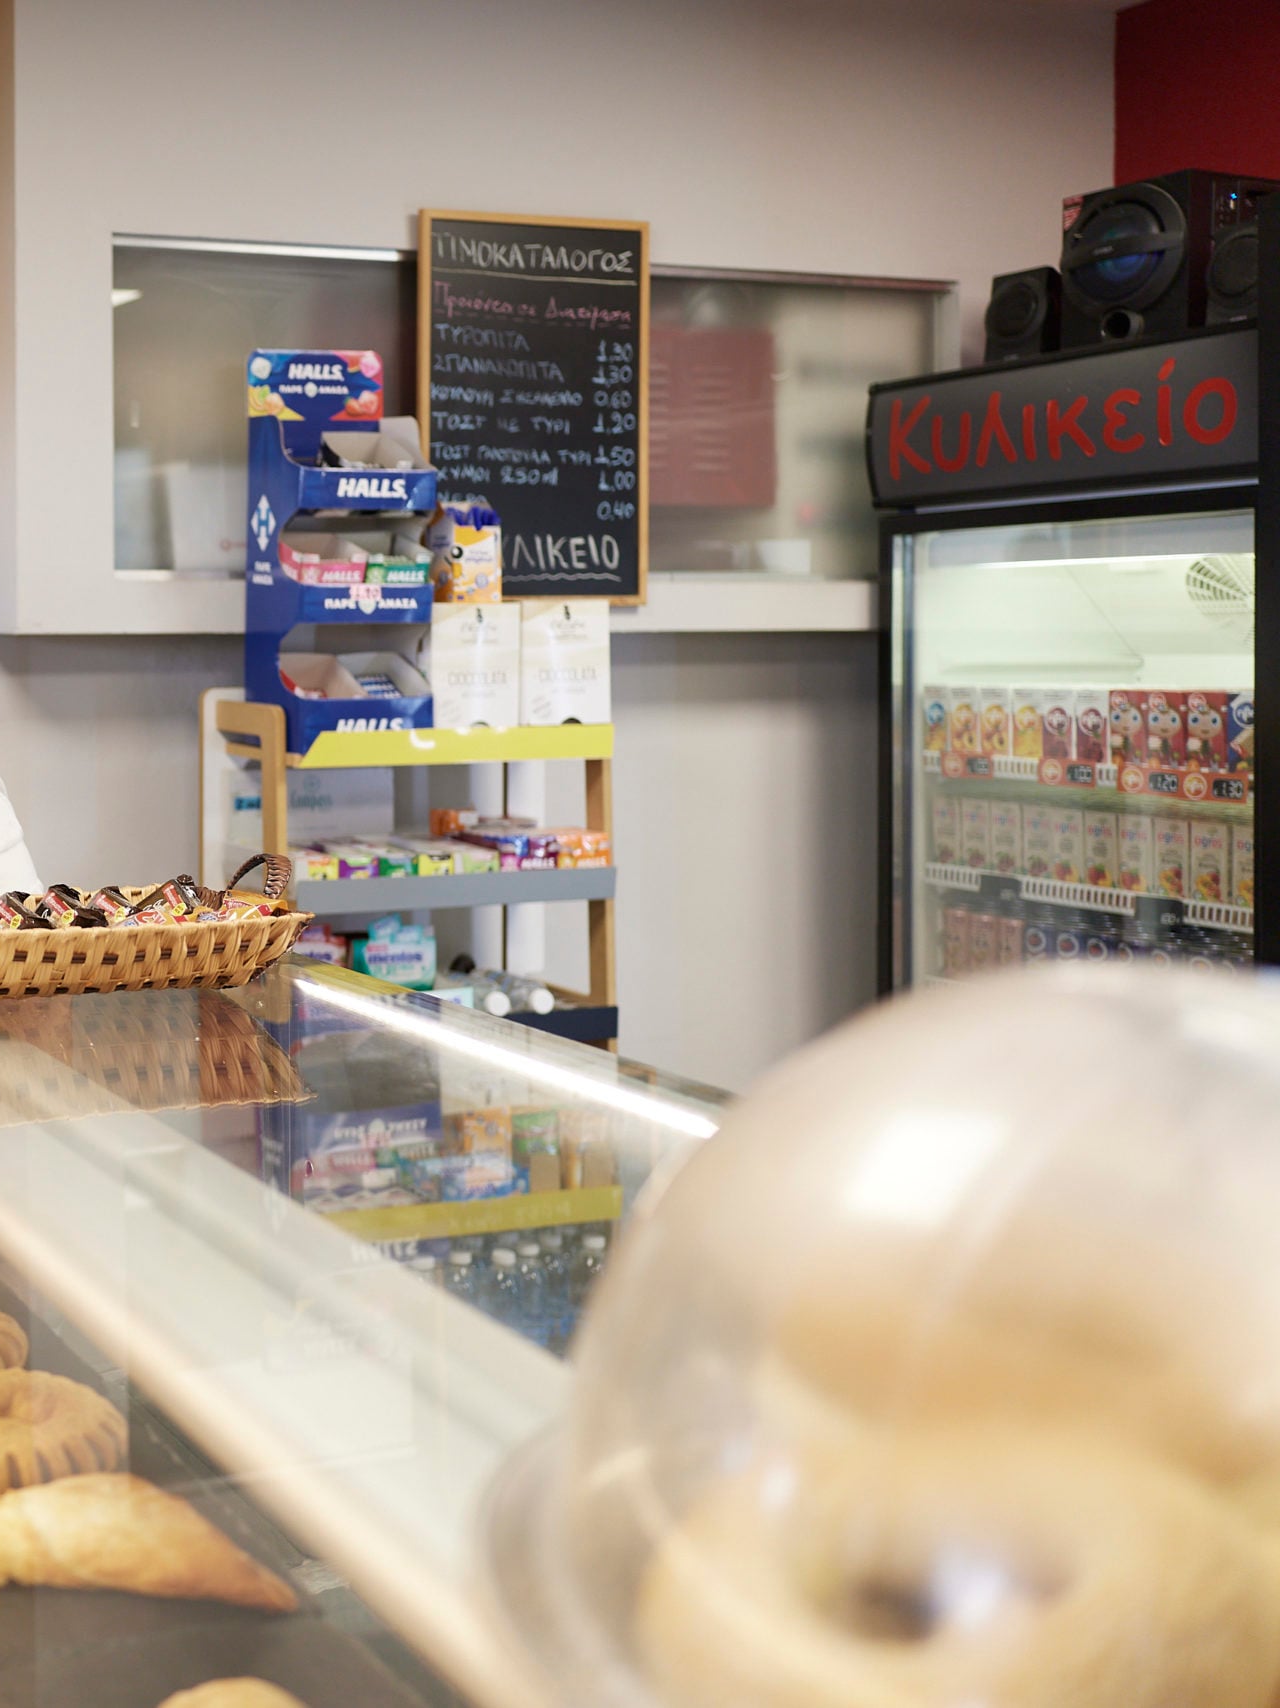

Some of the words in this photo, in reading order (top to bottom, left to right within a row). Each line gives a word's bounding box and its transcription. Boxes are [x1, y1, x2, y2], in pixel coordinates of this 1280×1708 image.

[432, 232, 634, 273] ΤΙΜΟΚΑΤΑΛΟΓΟΣ
[434, 323, 530, 352] ΤΥΡΟΠΙΤΑ
[288, 362, 345, 382] HALLS
[434, 354, 565, 383] ΣΠΑΝΑΚΟΠΙΤΑ
[431, 411, 485, 433] ΤΟΣΤ
[431, 441, 470, 461] ΤΟΣΤ
[336, 477, 409, 499] HALLS
[321, 570, 362, 583] HALLS
[386, 570, 425, 582] HALLS
[324, 598, 356, 609] ΠΑΡΕ
